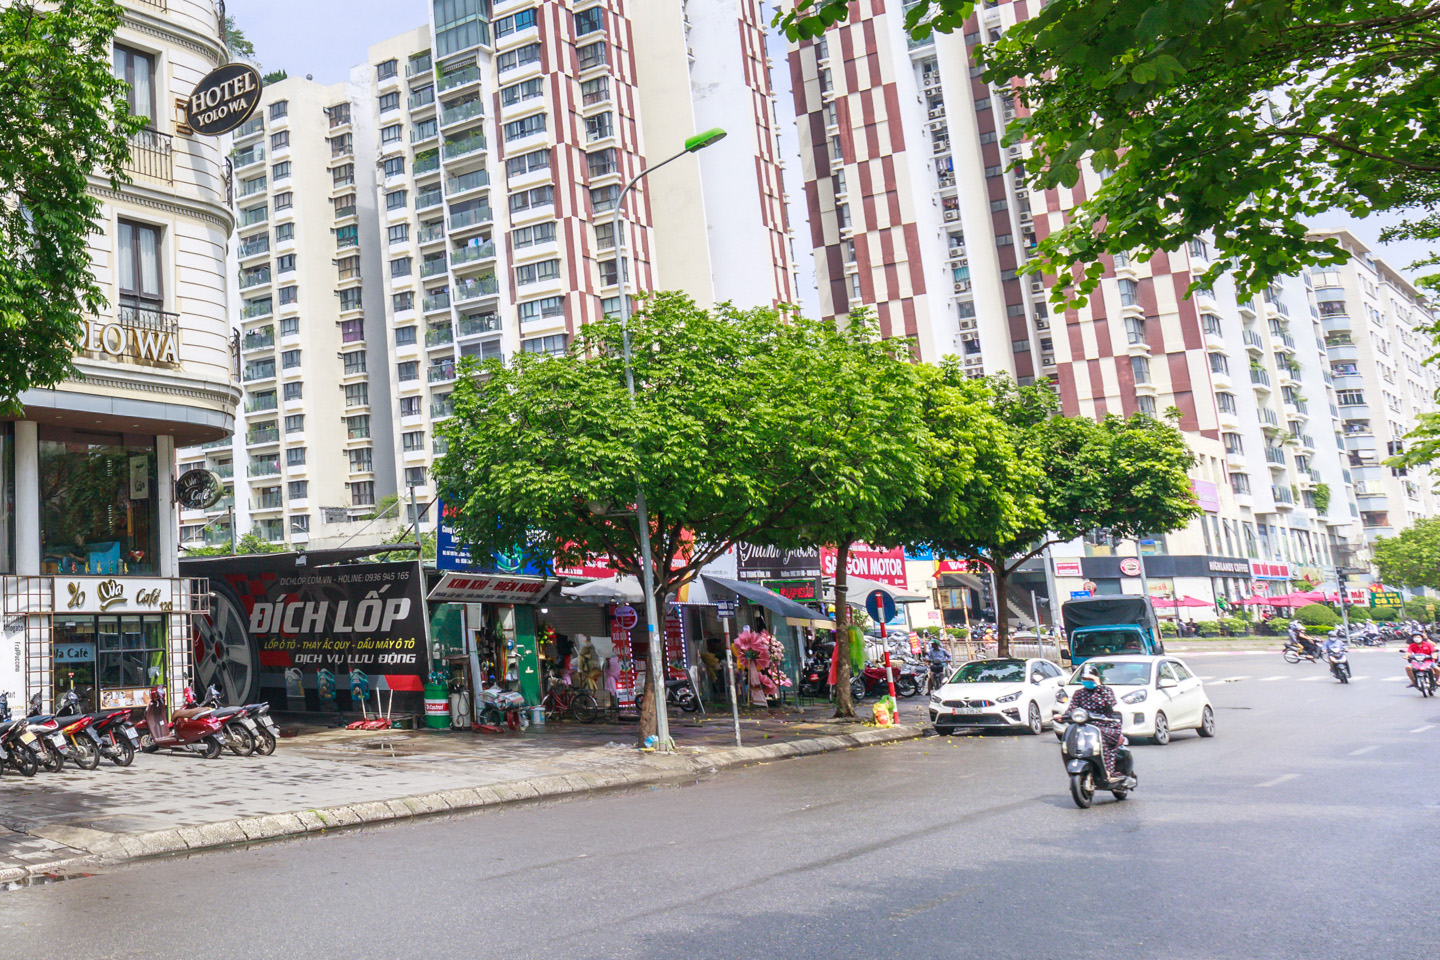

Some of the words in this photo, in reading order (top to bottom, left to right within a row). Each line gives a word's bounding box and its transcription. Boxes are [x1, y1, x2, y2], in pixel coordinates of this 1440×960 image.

[191, 71, 256, 115] HOTEL
[870, 557, 904, 576] MOTOR
[280, 577, 332, 586] DICHLOP.COM.VN
[365, 573, 381, 582] 0936
[383, 572, 395, 581] 945
[397, 571, 409, 580] 165
[136, 587, 161, 608] Café
[160, 601, 173, 611] 120
[248, 593, 329, 634] ĐÍCH
[333, 584, 411, 633] LỐP
[67, 647, 89, 658] Café
[302, 641, 322, 649] THAY
[334, 641, 351, 651] QUY
[376, 638, 395, 649] MÁY
[295, 653, 323, 665] DỊCH
[327, 653, 344, 666] VỤ
[378, 651, 417, 666] ĐỘNG
